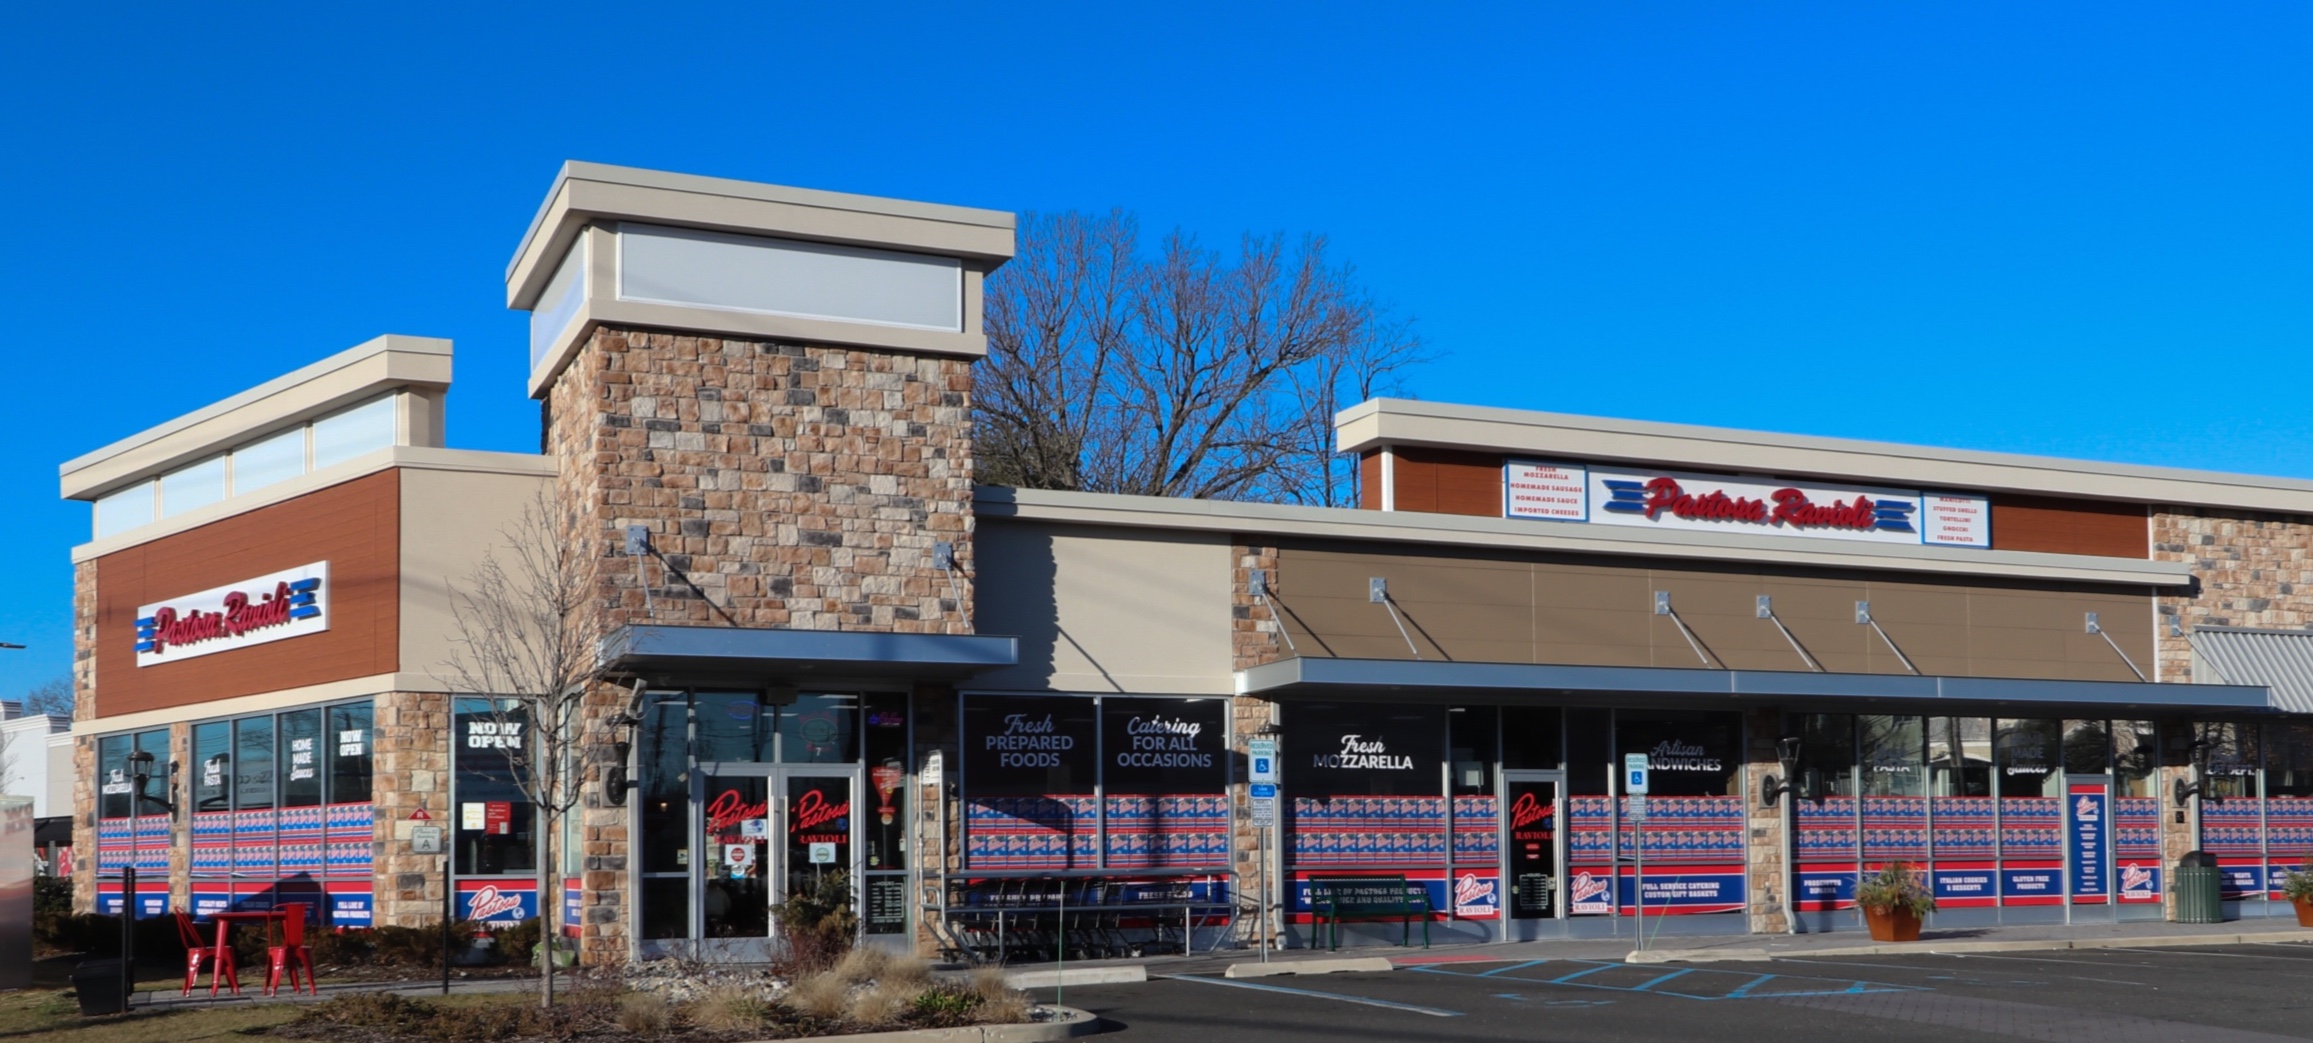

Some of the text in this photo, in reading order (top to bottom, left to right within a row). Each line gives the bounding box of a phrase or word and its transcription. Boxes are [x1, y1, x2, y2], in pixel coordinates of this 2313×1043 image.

[1523, 471, 1569, 481] MOZZARELLA
[1535, 465, 1557, 473] FRESH
[1510, 482, 1583, 493] HOMEMADE SAUSAGE
[1515, 494, 1555, 503] HOMEMADE
[1645, 476, 1875, 528] Pastosa Ravioli
[1514, 506, 1579, 517] IMPORTED CHEESES
[1933, 505, 1956, 513] STUFFED
[1939, 515, 1971, 523] TORTELLINI
[1943, 525, 1969, 533] GNOCCHI
[1955, 535, 1973, 543] PASTA
[154, 581, 293, 654] Pastosa Ravioli
[468, 721, 522, 736] NOW
[1004, 713, 1055, 735] Fresh
[1127, 714, 1201, 739] Catering
[340, 729, 363, 744] NOW
[468, 735, 522, 749] OPEN
[985, 735, 1074, 751] PREPARED
[1132, 735, 1198, 752] FOR ALL
[291, 738, 313, 752] HOME
[340, 742, 364, 757] OPEN
[1250, 742, 1275, 750] RESERVED
[1340, 734, 1387, 755] Fresh
[1649, 739, 1705, 757] Artisan
[292, 751, 312, 765] MADE
[1000, 752, 1061, 768] FOODS
[1117, 752, 1213, 768] OCCASIONS
[2011, 747, 2044, 759] MADE
[1313, 754, 1414, 770] MOZZARELLA
[1646, 757, 1722, 772] ANDWICHES
[290, 763, 314, 782] Sauces
[416, 811, 424, 819] R
[707, 788, 769, 835] Pastosa
[790, 788, 850, 833] Pastosa
[1510, 792, 1555, 830] Pastosa
[713, 834, 765, 845] RAVIOLI
[799, 833, 848, 844] RAVIOLI
[1515, 831, 1554, 840] RAVIOLI
[421, 839, 432, 850] A
[1803, 879, 1842, 887] PROSCIUTTO
[1939, 876, 1988, 885] ITALIAN COOKIES
[2012, 875, 2050, 884] GLUTEN FREE
[2121, 862, 2152, 893] Pastosa
[1454, 873, 1495, 907] Pastosa
[1570, 871, 1608, 905] Pastosa
[1660, 882, 1687, 890] SERVICE
[1688, 881, 1720, 890] CATERING
[2017, 882, 2046, 890] PRODUCTS
[1644, 889, 1719, 899] CUSTOM GIFT BASKETS
[467, 884, 522, 921] Pastosa
[1574, 903, 1608, 911] RAVIOLI
[1458, 906, 1493, 915] RAVIOLI
